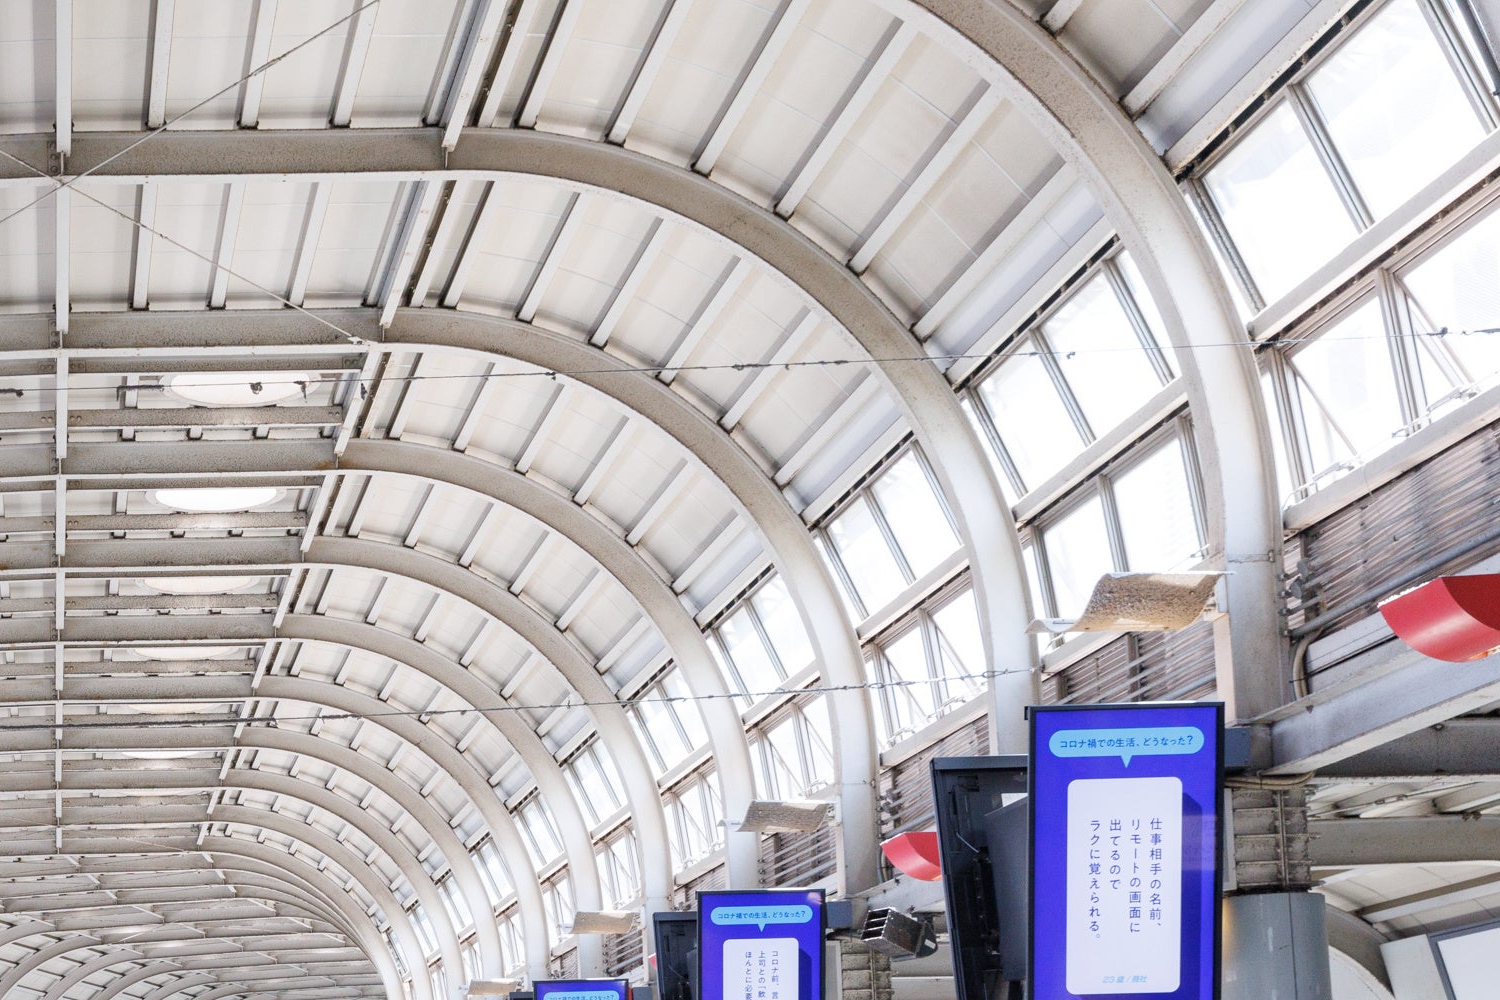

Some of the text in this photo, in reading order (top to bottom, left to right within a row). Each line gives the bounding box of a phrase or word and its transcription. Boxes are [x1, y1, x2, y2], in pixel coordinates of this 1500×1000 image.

[1059, 735, 1194, 749] コロナ禍での生活、どうなった？
[1088, 820, 1101, 939] ラクに覚えられる。
[1109, 819, 1122, 890] 出てるので
[1129, 819, 1142, 933] リモートの画面に
[1150, 817, 1163, 927] 仕事相手の名前、
